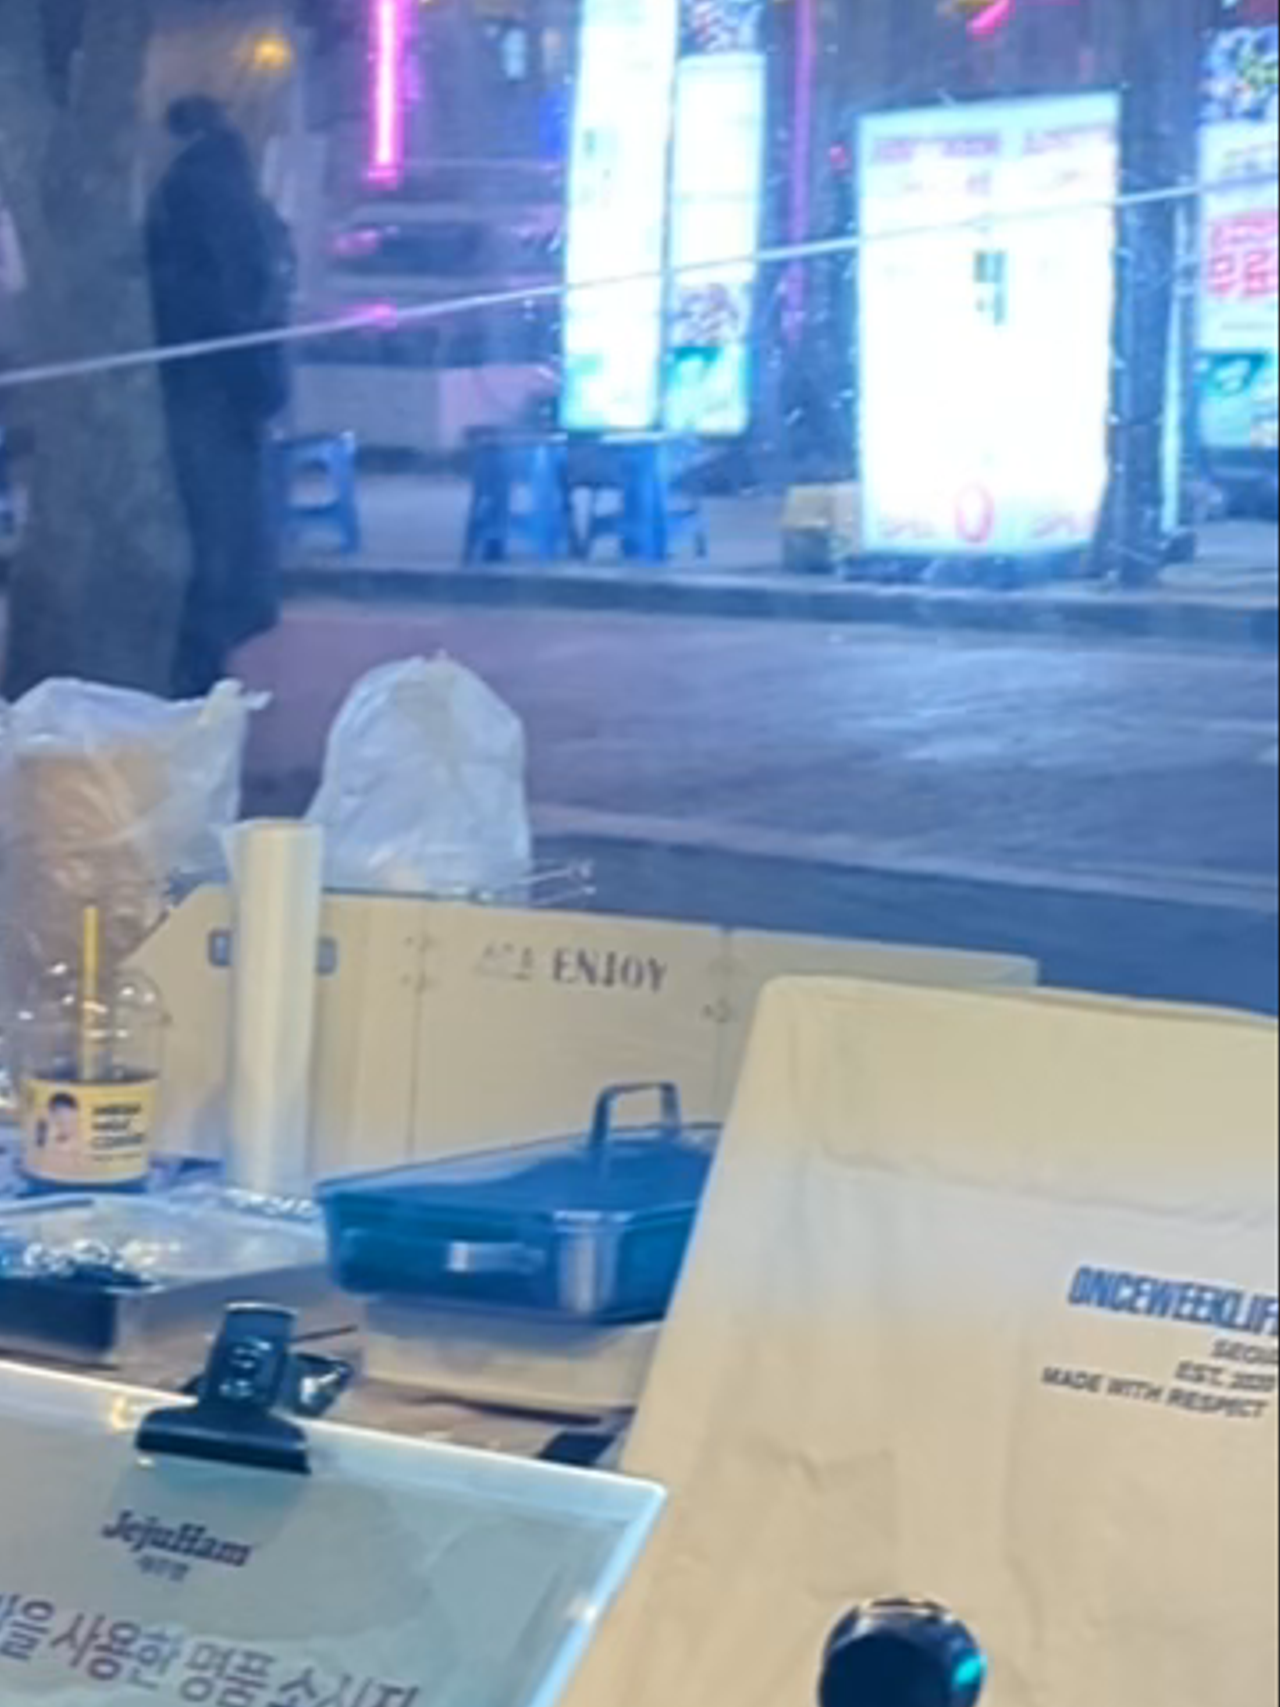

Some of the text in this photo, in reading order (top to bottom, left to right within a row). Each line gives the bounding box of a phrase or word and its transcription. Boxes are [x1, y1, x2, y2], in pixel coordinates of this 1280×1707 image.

[552, 945, 669, 994] ENJOY
[1041, 1366, 1270, 1419] MADE WITH RESPECT
[101, 1508, 253, 1568] JejuHam
[48, 1608, 184, 1691] 사용한
